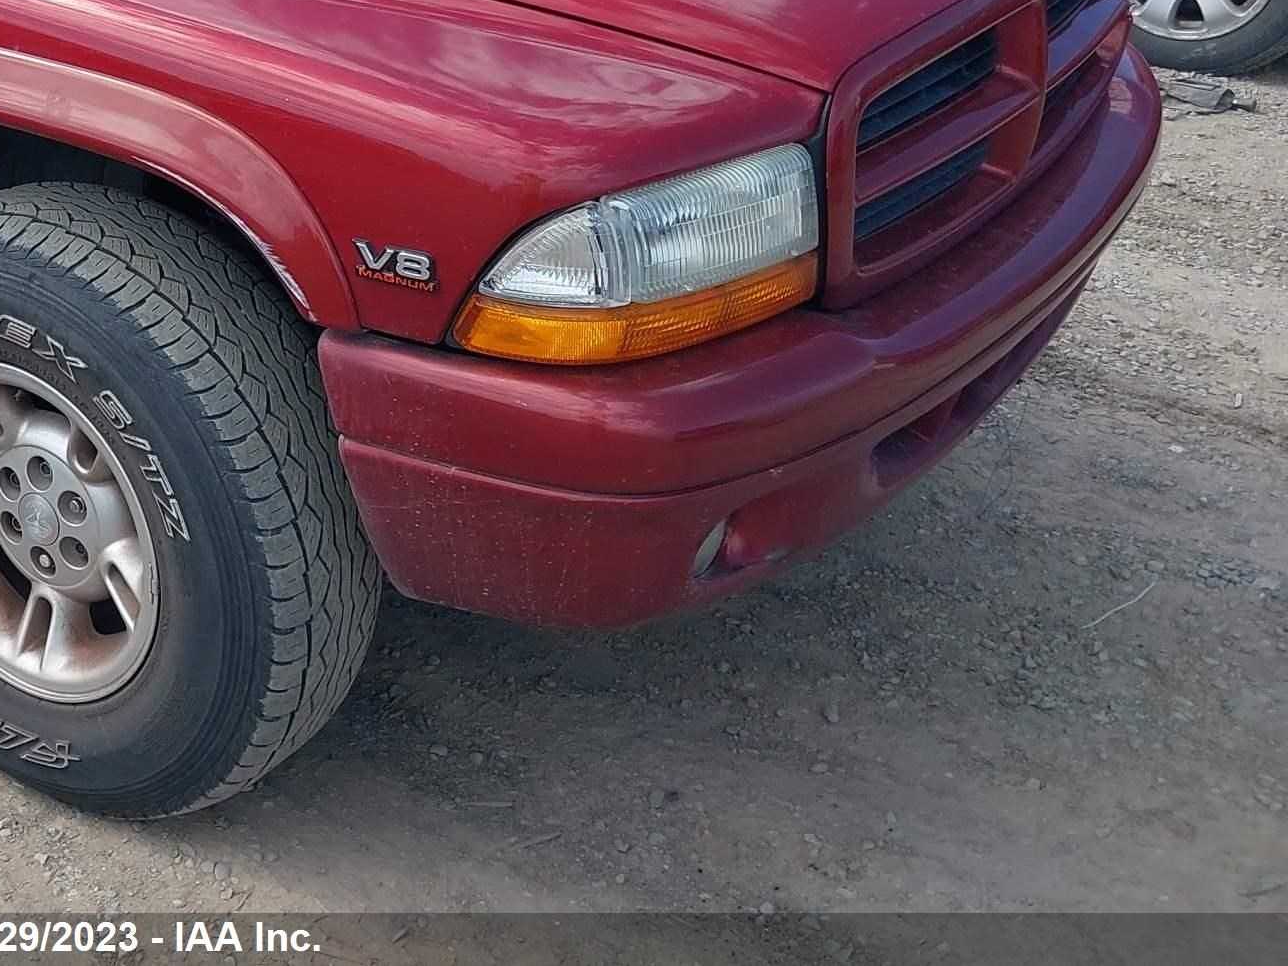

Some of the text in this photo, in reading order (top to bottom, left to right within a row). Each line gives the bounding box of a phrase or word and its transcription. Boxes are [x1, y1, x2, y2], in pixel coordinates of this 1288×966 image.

[353, 239, 432, 281] V8
[356, 265, 436, 292] MAGNUM
[92, 390, 192, 541] S/TZ
